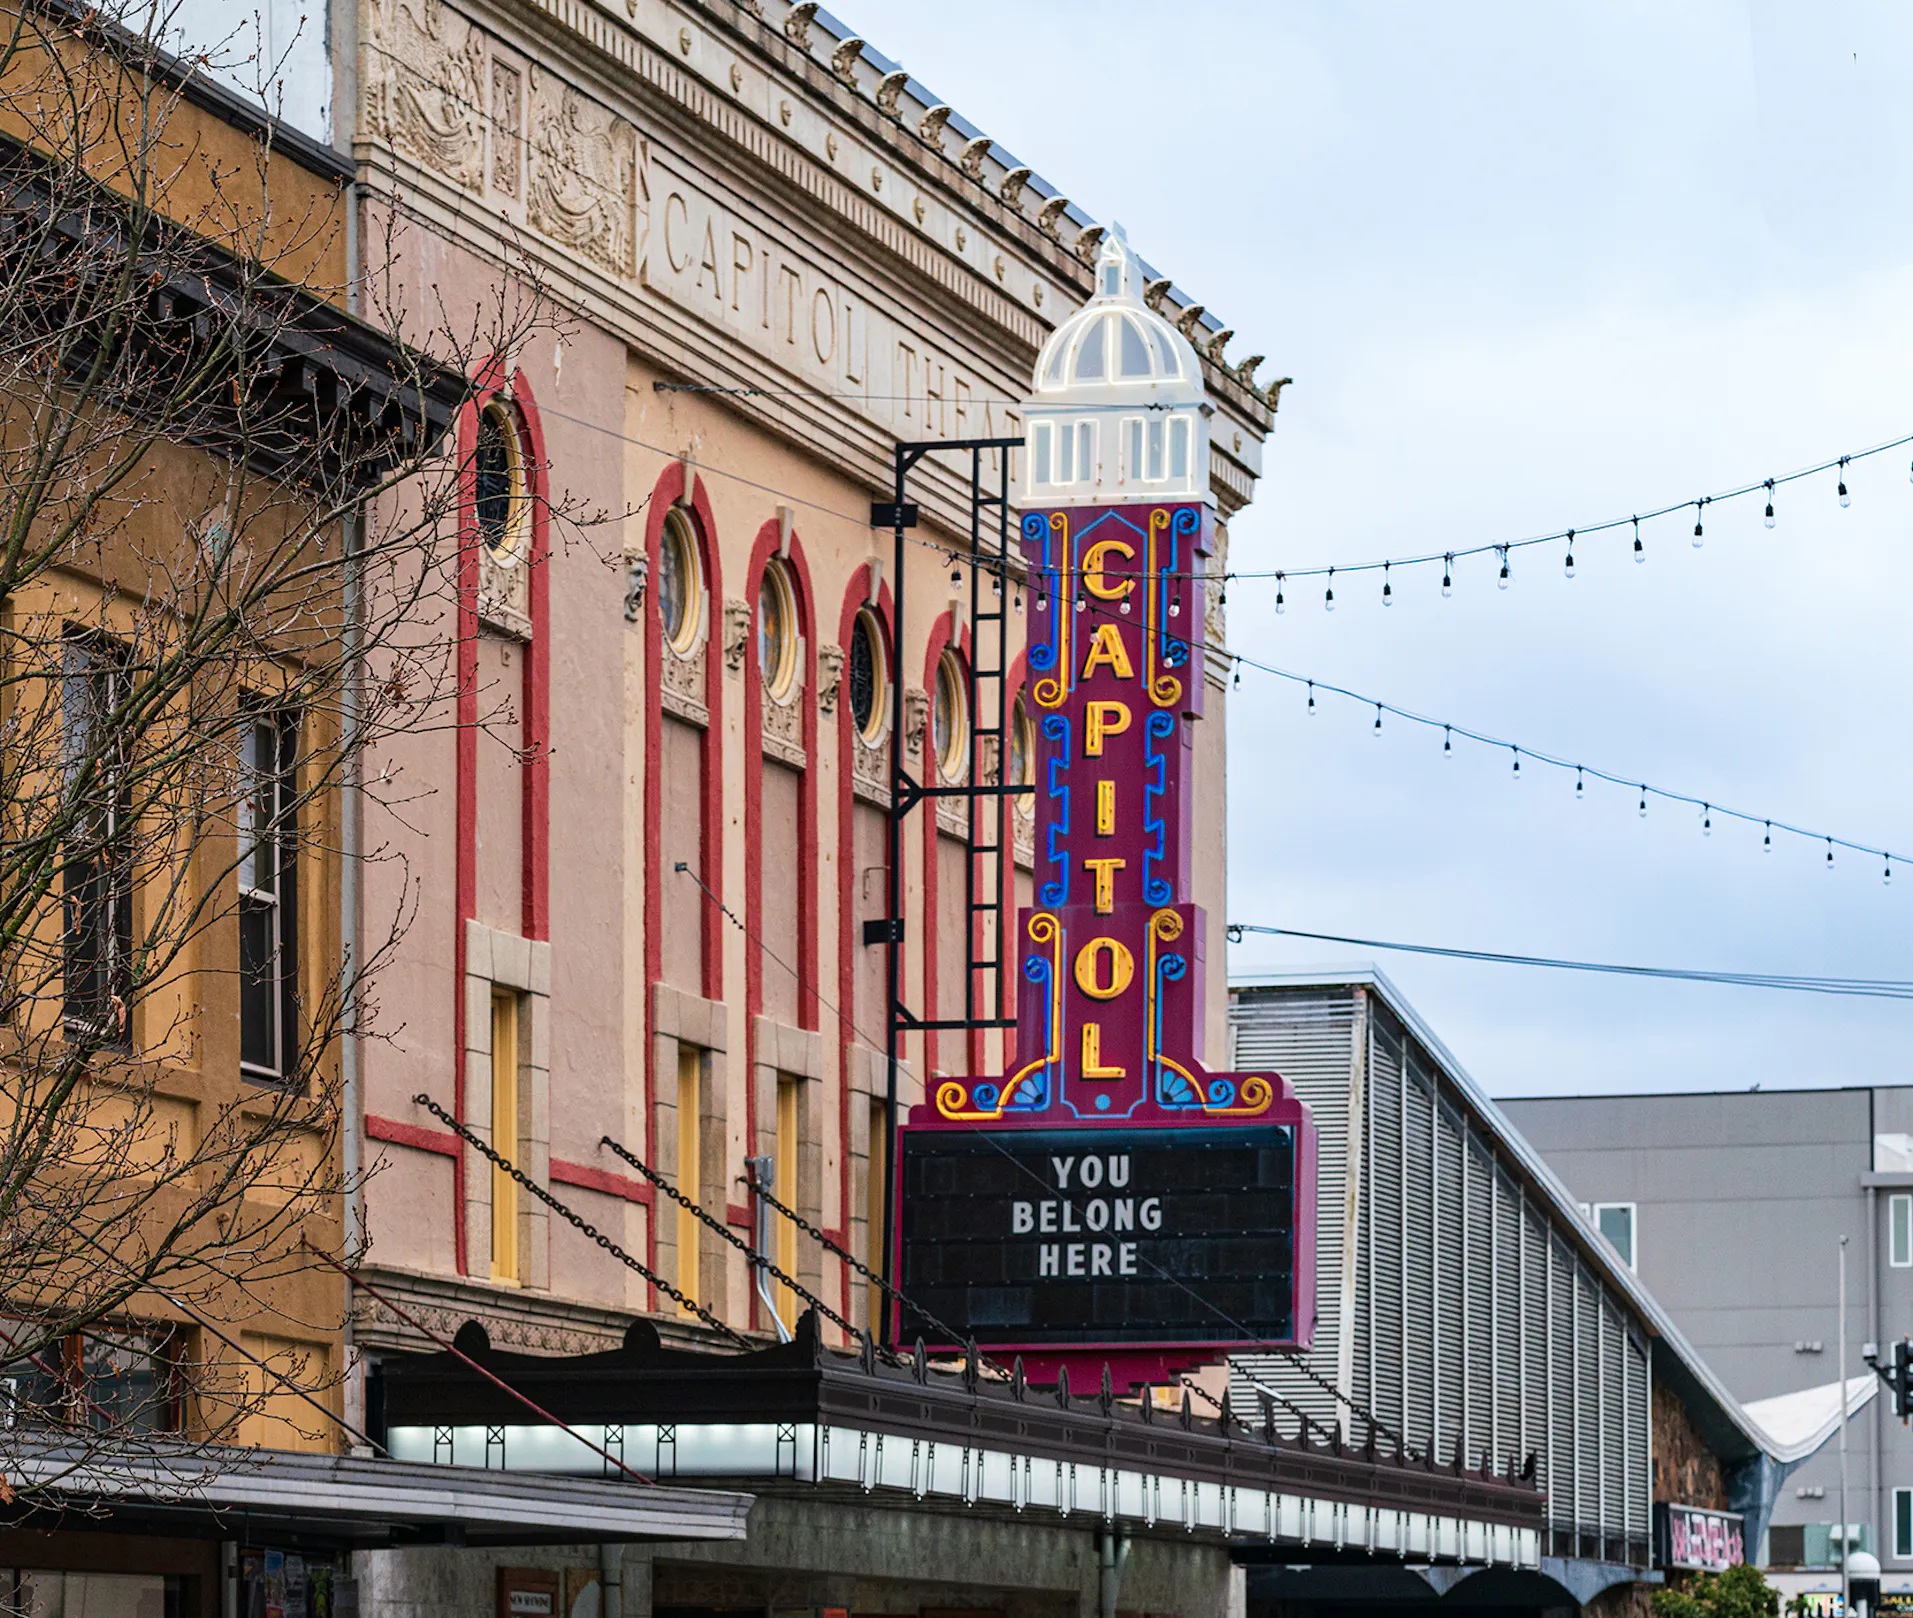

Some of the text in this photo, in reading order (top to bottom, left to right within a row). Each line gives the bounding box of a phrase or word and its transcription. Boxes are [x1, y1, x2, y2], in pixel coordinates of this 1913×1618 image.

[664, 191, 1023, 483] CAPITOL THEAT
[1074, 540, 1137, 1080] CAPITOL
[1051, 1154, 1130, 1189] YOU
[1012, 1197, 1163, 1234] BELONG
[1039, 1242, 1138, 1277] HERE
